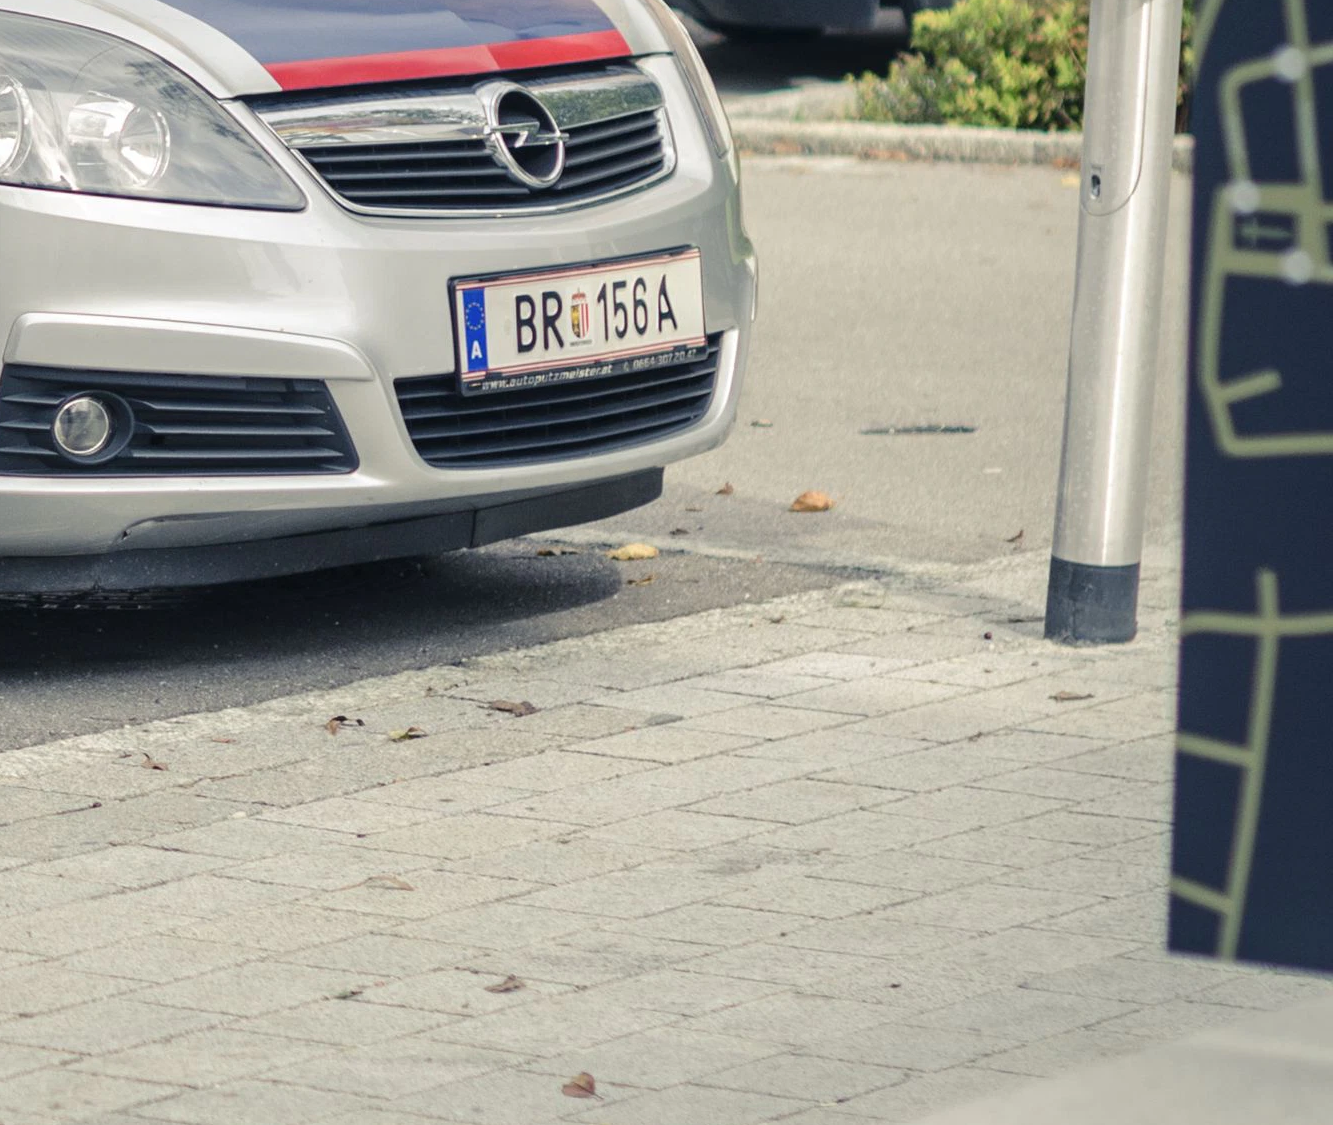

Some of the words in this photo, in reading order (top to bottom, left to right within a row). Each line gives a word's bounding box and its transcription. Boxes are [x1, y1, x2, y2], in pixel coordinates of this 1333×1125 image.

[515, 290, 565, 354] BR
[597, 277, 648, 342] 156
[658, 274, 678, 334] A
[471, 339, 483, 360] A
